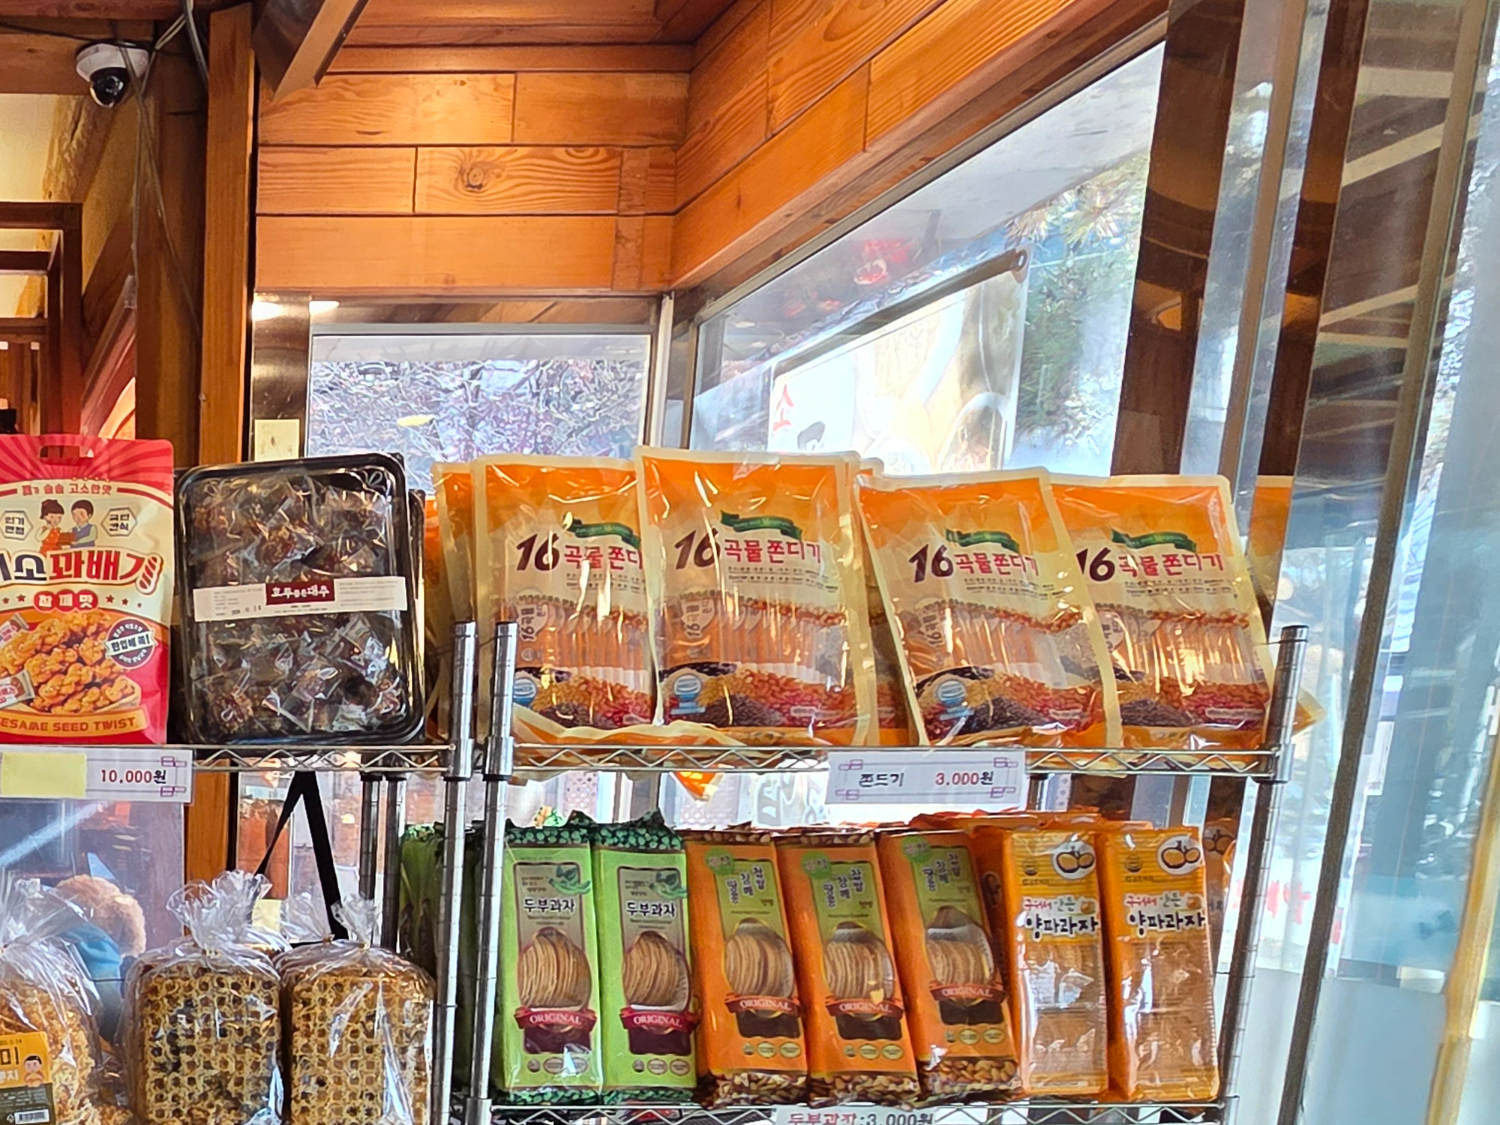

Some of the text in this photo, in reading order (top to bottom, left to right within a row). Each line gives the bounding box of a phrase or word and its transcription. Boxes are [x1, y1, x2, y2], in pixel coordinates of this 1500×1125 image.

[516, 529, 560, 571] 16
[608, 544, 643, 570] 쫀디
[674, 527, 822, 571] 16 곡물 쫀디기
[908, 544, 955, 583] 16
[1162, 552, 1225, 577] 쫀디기
[52, 721, 89, 732] SEED
[93, 716, 136, 732] TWIST
[858, 773, 904, 788] 쫀드기
[523, 897, 576, 913] 두부과자
[626, 901, 676, 917] 두부과자
[1026, 913, 1099, 939] 양파과자
[1129, 910, 1205, 936] 양파과자
[941, 986, 994, 999] ORIGINAL
[739, 999, 790, 1012] ORIGINAL
[838, 1000, 892, 1013] ORIGINAL
[529, 1012, 582, 1027] ORIGINAL
[632, 1012, 683, 1027] ORIGINAL
